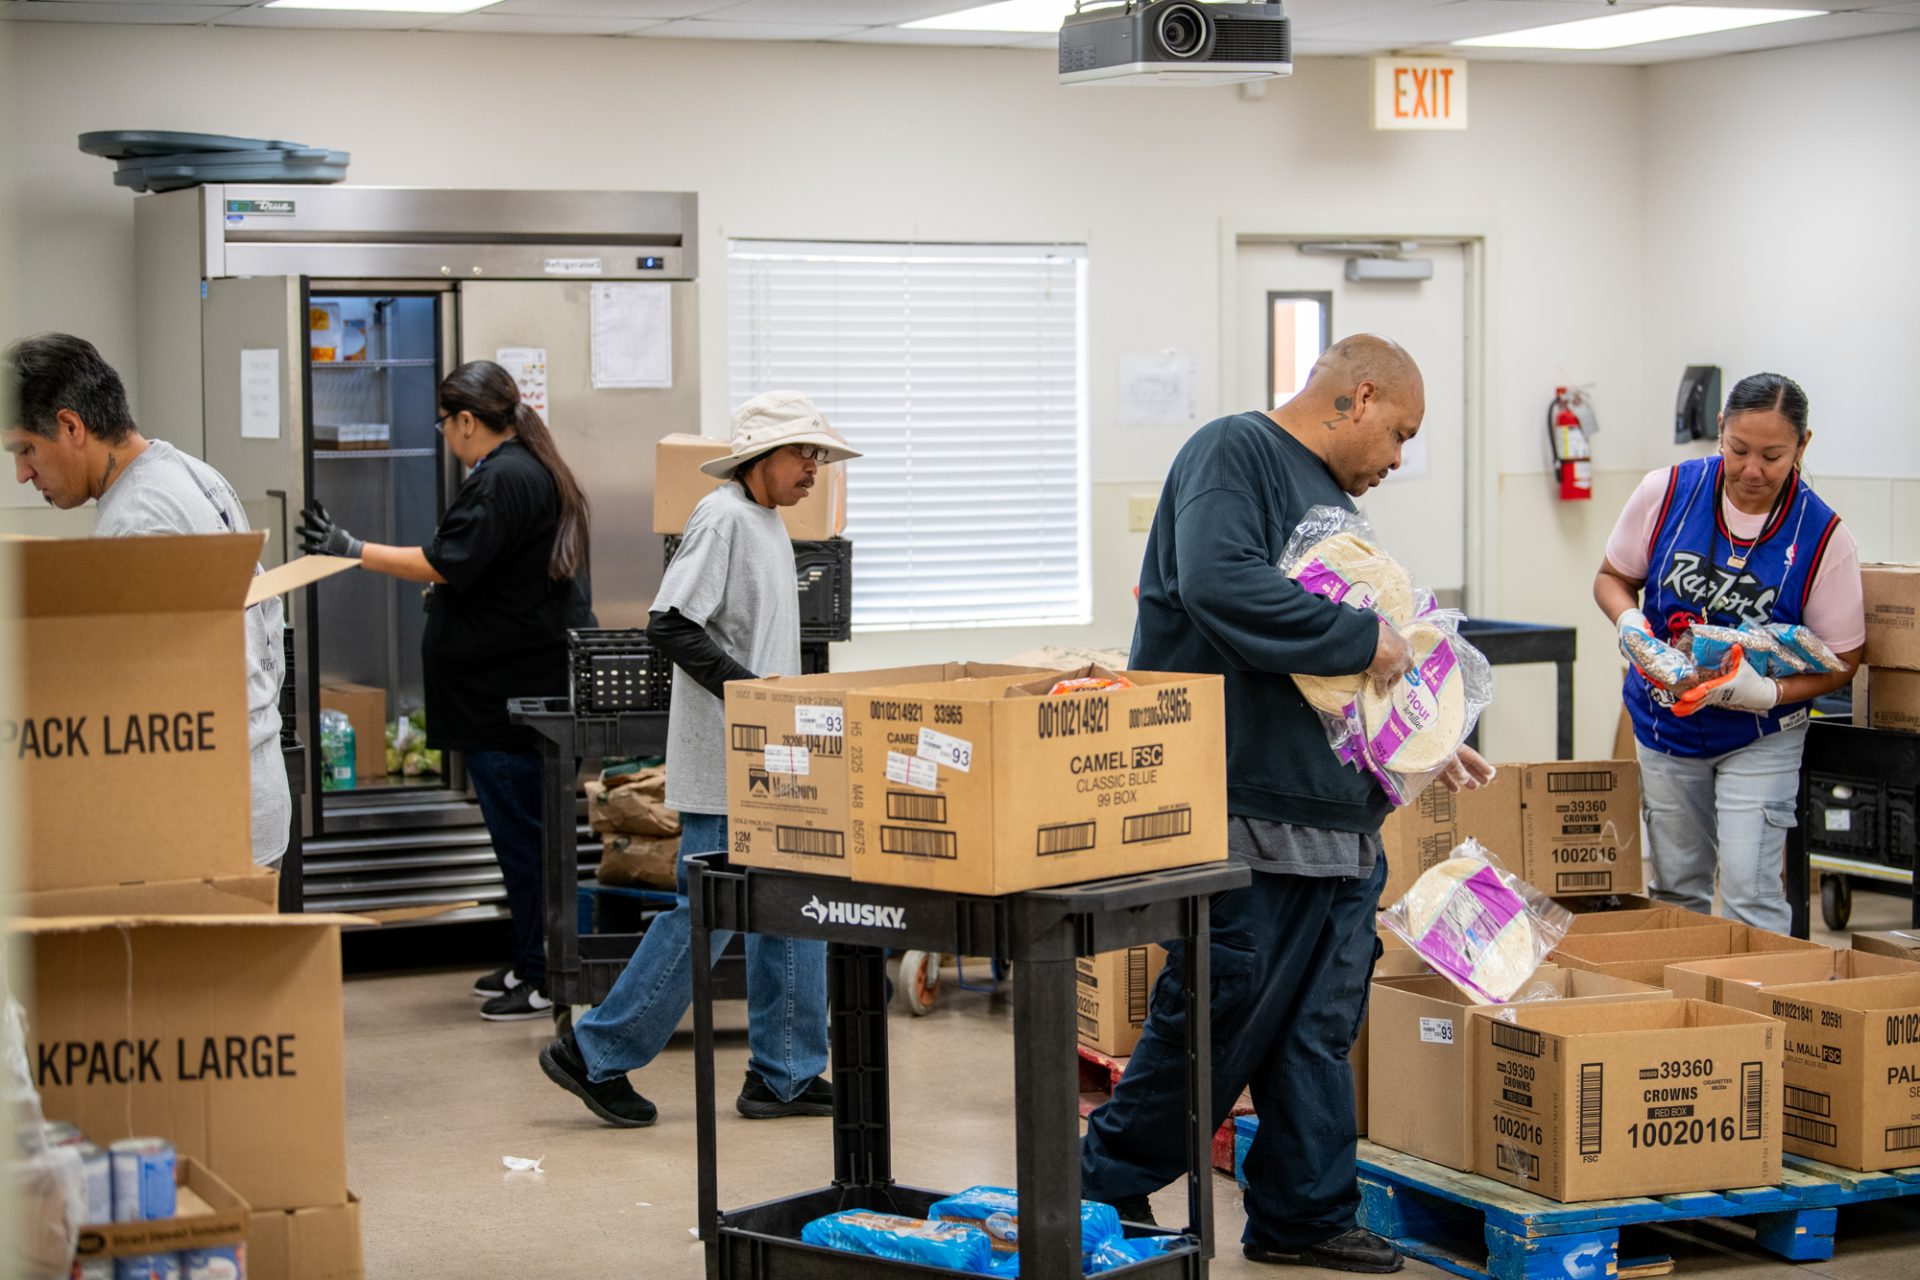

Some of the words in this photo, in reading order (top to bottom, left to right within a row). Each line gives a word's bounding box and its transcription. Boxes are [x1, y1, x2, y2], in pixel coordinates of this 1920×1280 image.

[1394, 67, 1454, 118] EXIT
[870, 701, 923, 722] 0010214921
[934, 704, 963, 725] 33965
[1406, 689, 1431, 720] Flour
[826, 716, 842, 732] 93
[1038, 697, 1109, 739] 0010214921
[103, 711, 216, 756] LARGE
[851, 746, 863, 773] 2325
[952, 747, 970, 767] 93
[1070, 751, 1128, 774] CAMEL
[1133, 745, 1163, 768] FSC
[1076, 774, 1125, 793] CLASSIC
[1129, 769, 1157, 787] BLUE
[1097, 793, 1111, 808] 99
[1113, 789, 1137, 806] BOX
[1570, 800, 1607, 813] 39360
[1563, 814, 1599, 823] CROWNS
[734, 831, 751, 842] 12M
[1551, 847, 1617, 863] 1002016
[1772, 1000, 1813, 1022] 0010221841
[1821, 1010, 1842, 1029] 20591
[1441, 1026, 1453, 1040] 93
[1886, 1013, 1920, 1046] 00102
[177, 1034, 297, 1081] LARGE
[1796, 1042, 1821, 1058] MALL
[1823, 1047, 1841, 1063] FSC
[1506, 1060, 1535, 1081] 39360
[1660, 1058, 1713, 1079] 39360
[1503, 1076, 1531, 1093] CROWNS
[1643, 1086, 1698, 1103] CROWNS
[1654, 1108, 1671, 1118] RED
[1672, 1106, 1687, 1116] BOX
[1493, 1114, 1543, 1145] 1002016
[1627, 1116, 1735, 1149] 1002016
[1583, 1155, 1599, 1163] FSC
